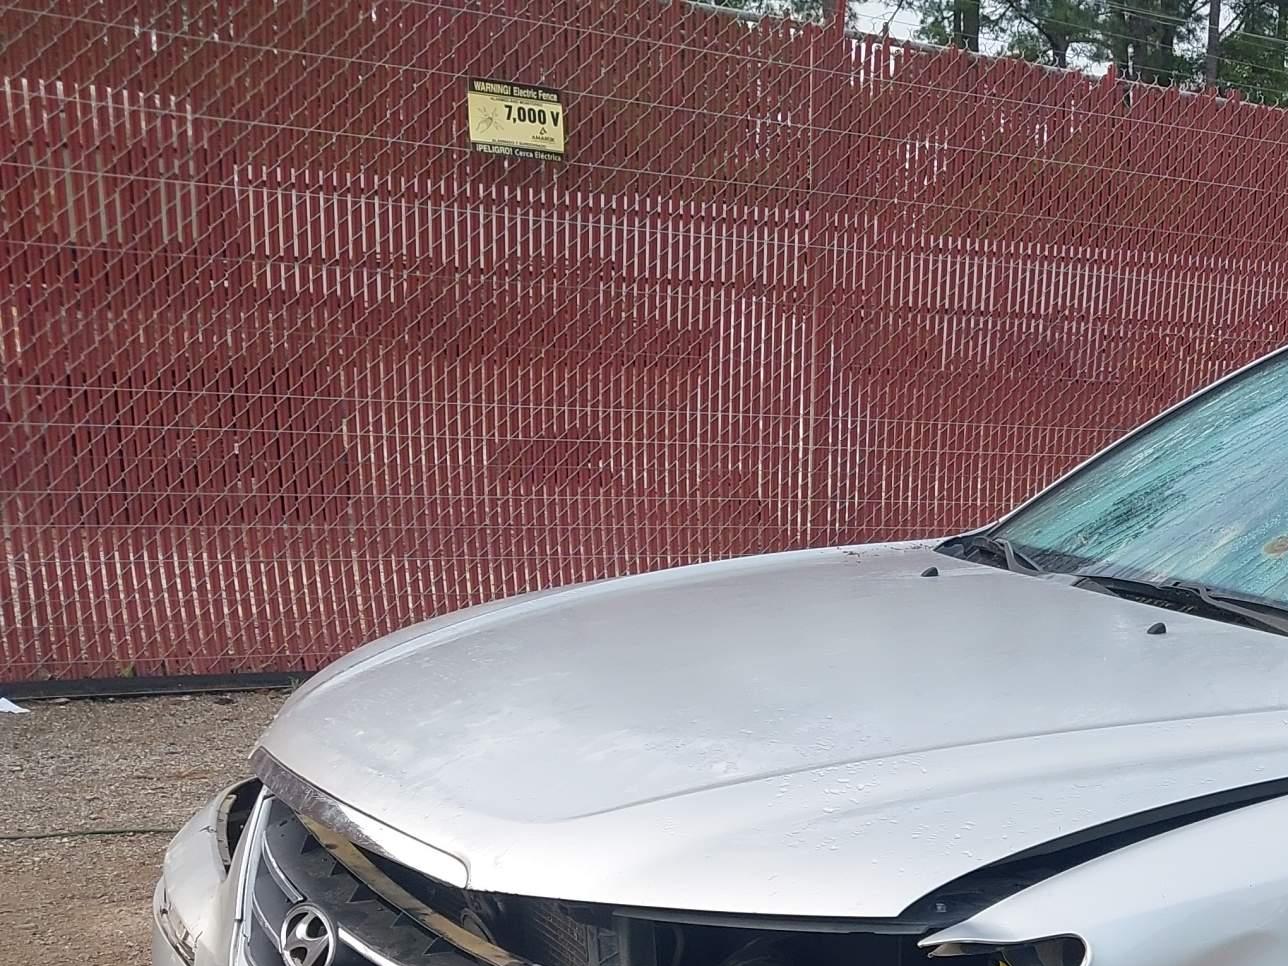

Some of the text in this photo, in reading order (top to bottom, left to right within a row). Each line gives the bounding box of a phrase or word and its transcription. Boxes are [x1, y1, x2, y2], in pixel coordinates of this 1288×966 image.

[474, 80, 558, 101] WARNING! Electric Fence
[504, 104, 560, 127] 7,000 V
[514, 149, 533, 158] Cerca
